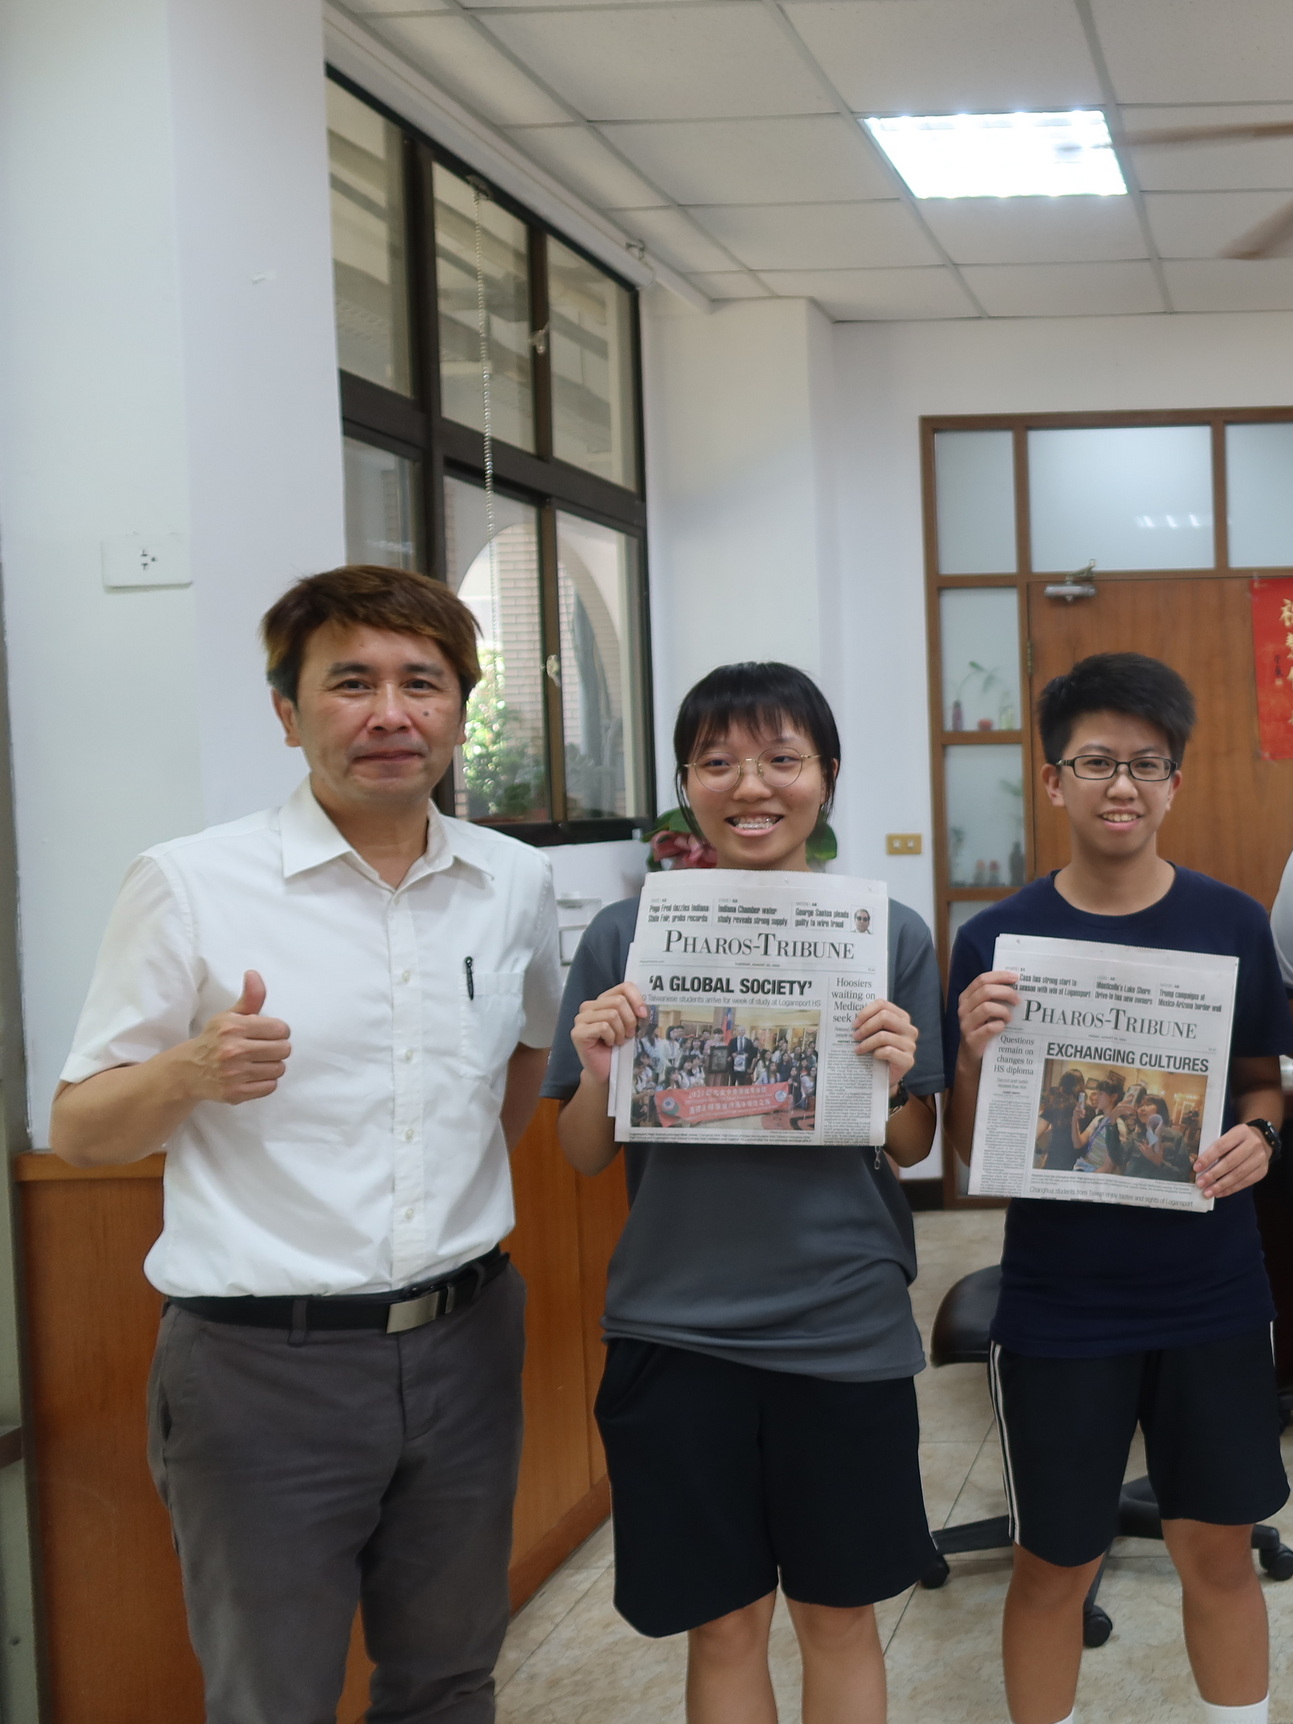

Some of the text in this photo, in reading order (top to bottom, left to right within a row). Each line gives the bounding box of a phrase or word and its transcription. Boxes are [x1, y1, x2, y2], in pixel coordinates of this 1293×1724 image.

[663, 930, 854, 959] PHAROS-TRIBUNE
[669, 976, 734, 993] GLOBAL
[837, 978, 872, 988] Hoosiers
[832, 990, 863, 1001] waiting
[833, 1013, 851, 1022] seek
[1022, 999, 1197, 1039] PHAROS-TRIBUNE
[1000, 1035, 1034, 1045] Questions
[998, 1046, 1022, 1054] remain
[997, 1055, 1024, 1065] changes
[1046, 1042, 1209, 1072] EXCHANGING CULTURES
[1006, 1067, 1033, 1075] diploma
